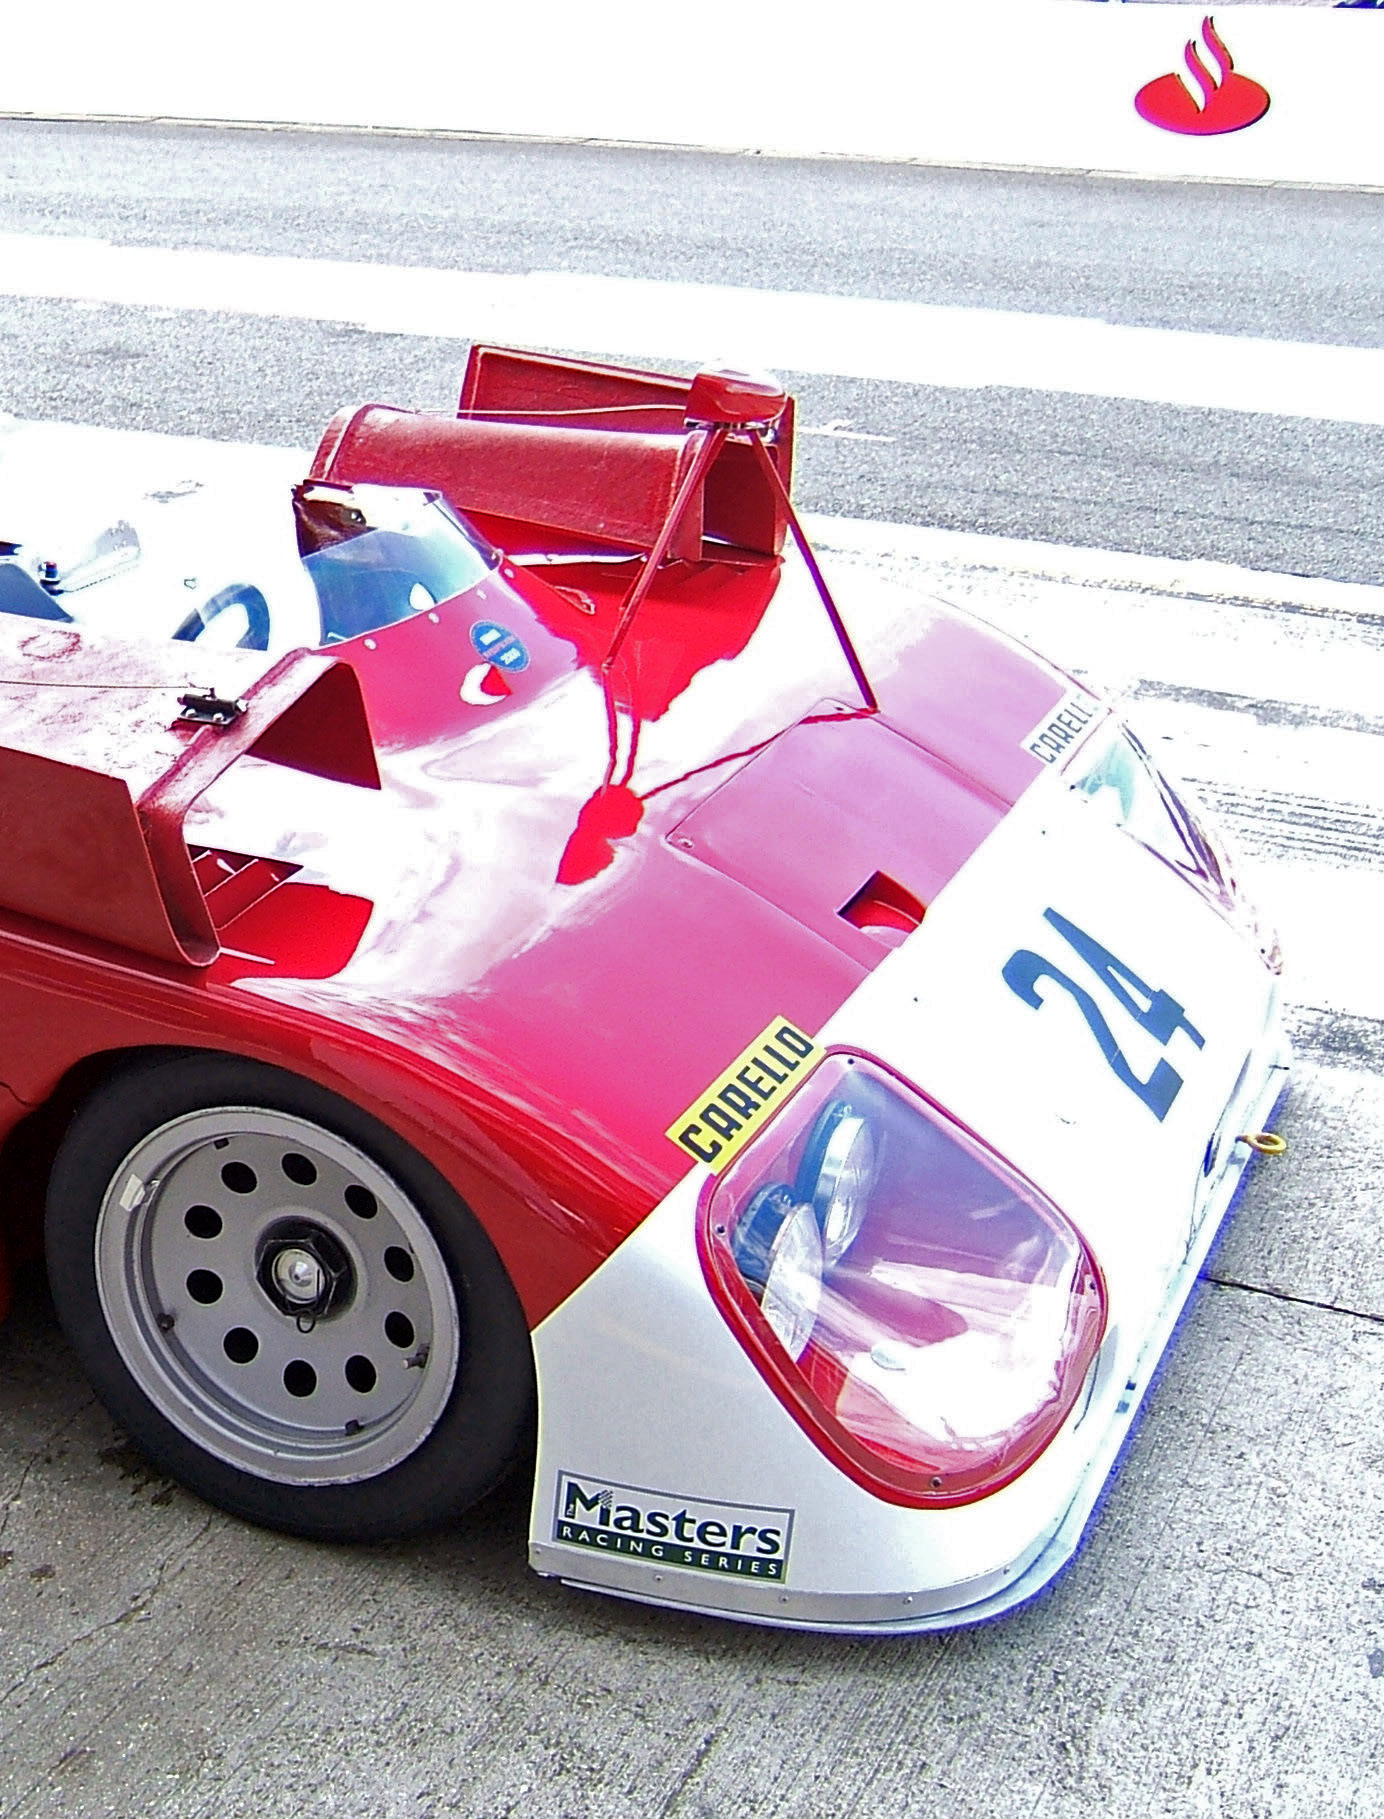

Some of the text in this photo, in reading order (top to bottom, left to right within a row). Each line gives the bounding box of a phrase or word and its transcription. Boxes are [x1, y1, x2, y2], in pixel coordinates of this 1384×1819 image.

[1029, 694, 1098, 764] CARELL
[1001, 906, 1206, 1124] 24
[678, 1026, 814, 1163] CARELLO
[562, 1526, 778, 1575] RACING SERIES
[564, 1481, 782, 1555] Masters
